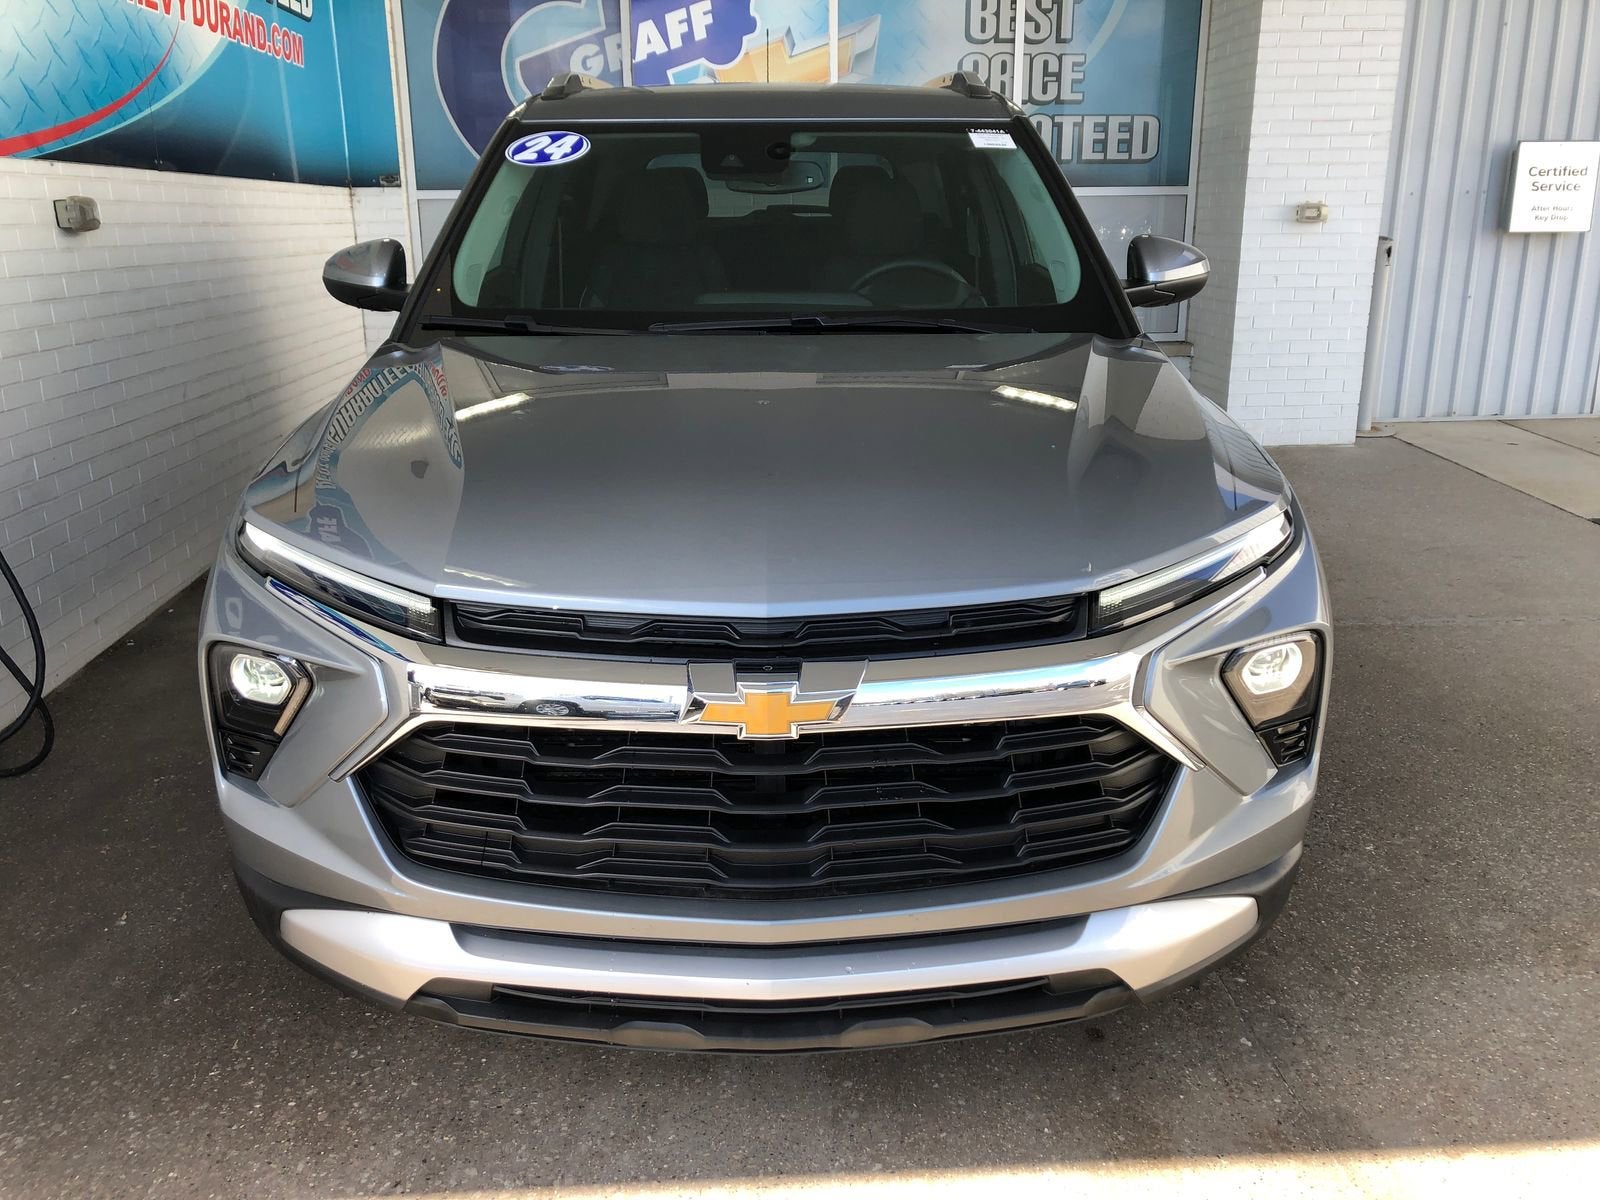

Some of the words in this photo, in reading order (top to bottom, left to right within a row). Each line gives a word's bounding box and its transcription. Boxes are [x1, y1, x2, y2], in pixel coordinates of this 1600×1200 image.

[965, 0, 1079, 44] BEST
[513, 134, 581, 161] 24
[1528, 166, 1588, 177] Certified
[1531, 181, 1581, 192] Service
